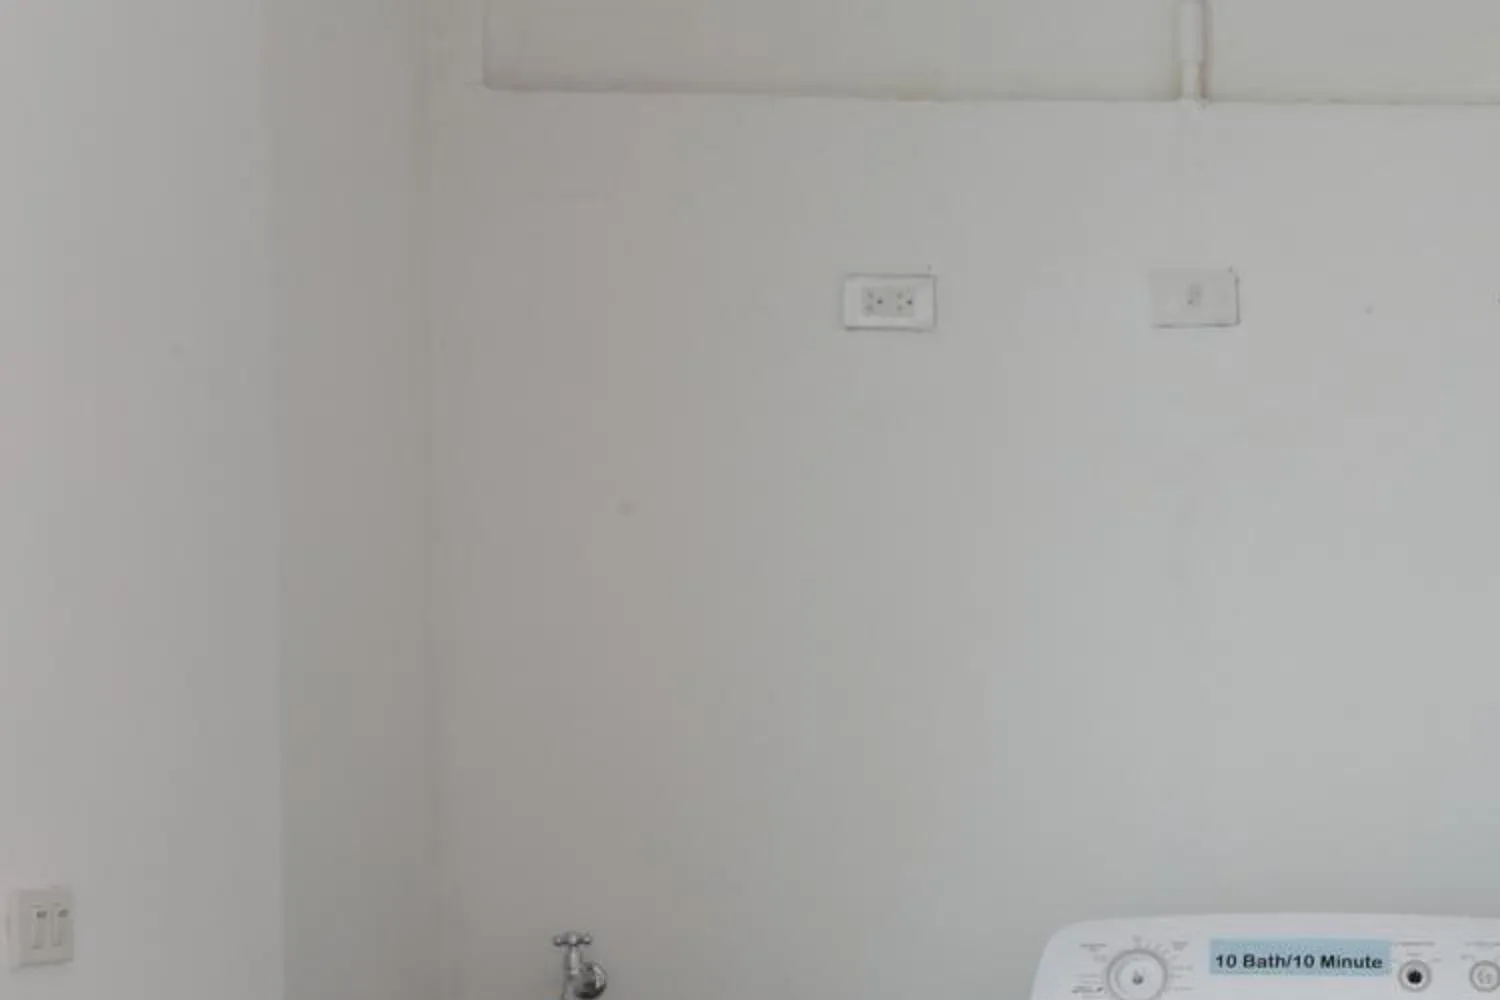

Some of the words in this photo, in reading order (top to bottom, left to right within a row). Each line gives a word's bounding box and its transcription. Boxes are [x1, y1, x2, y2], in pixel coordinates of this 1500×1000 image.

[1215, 953, 1237, 969] 10
[1242, 953, 1315, 969] Bath/10
[1319, 953, 1384, 969] Minute
